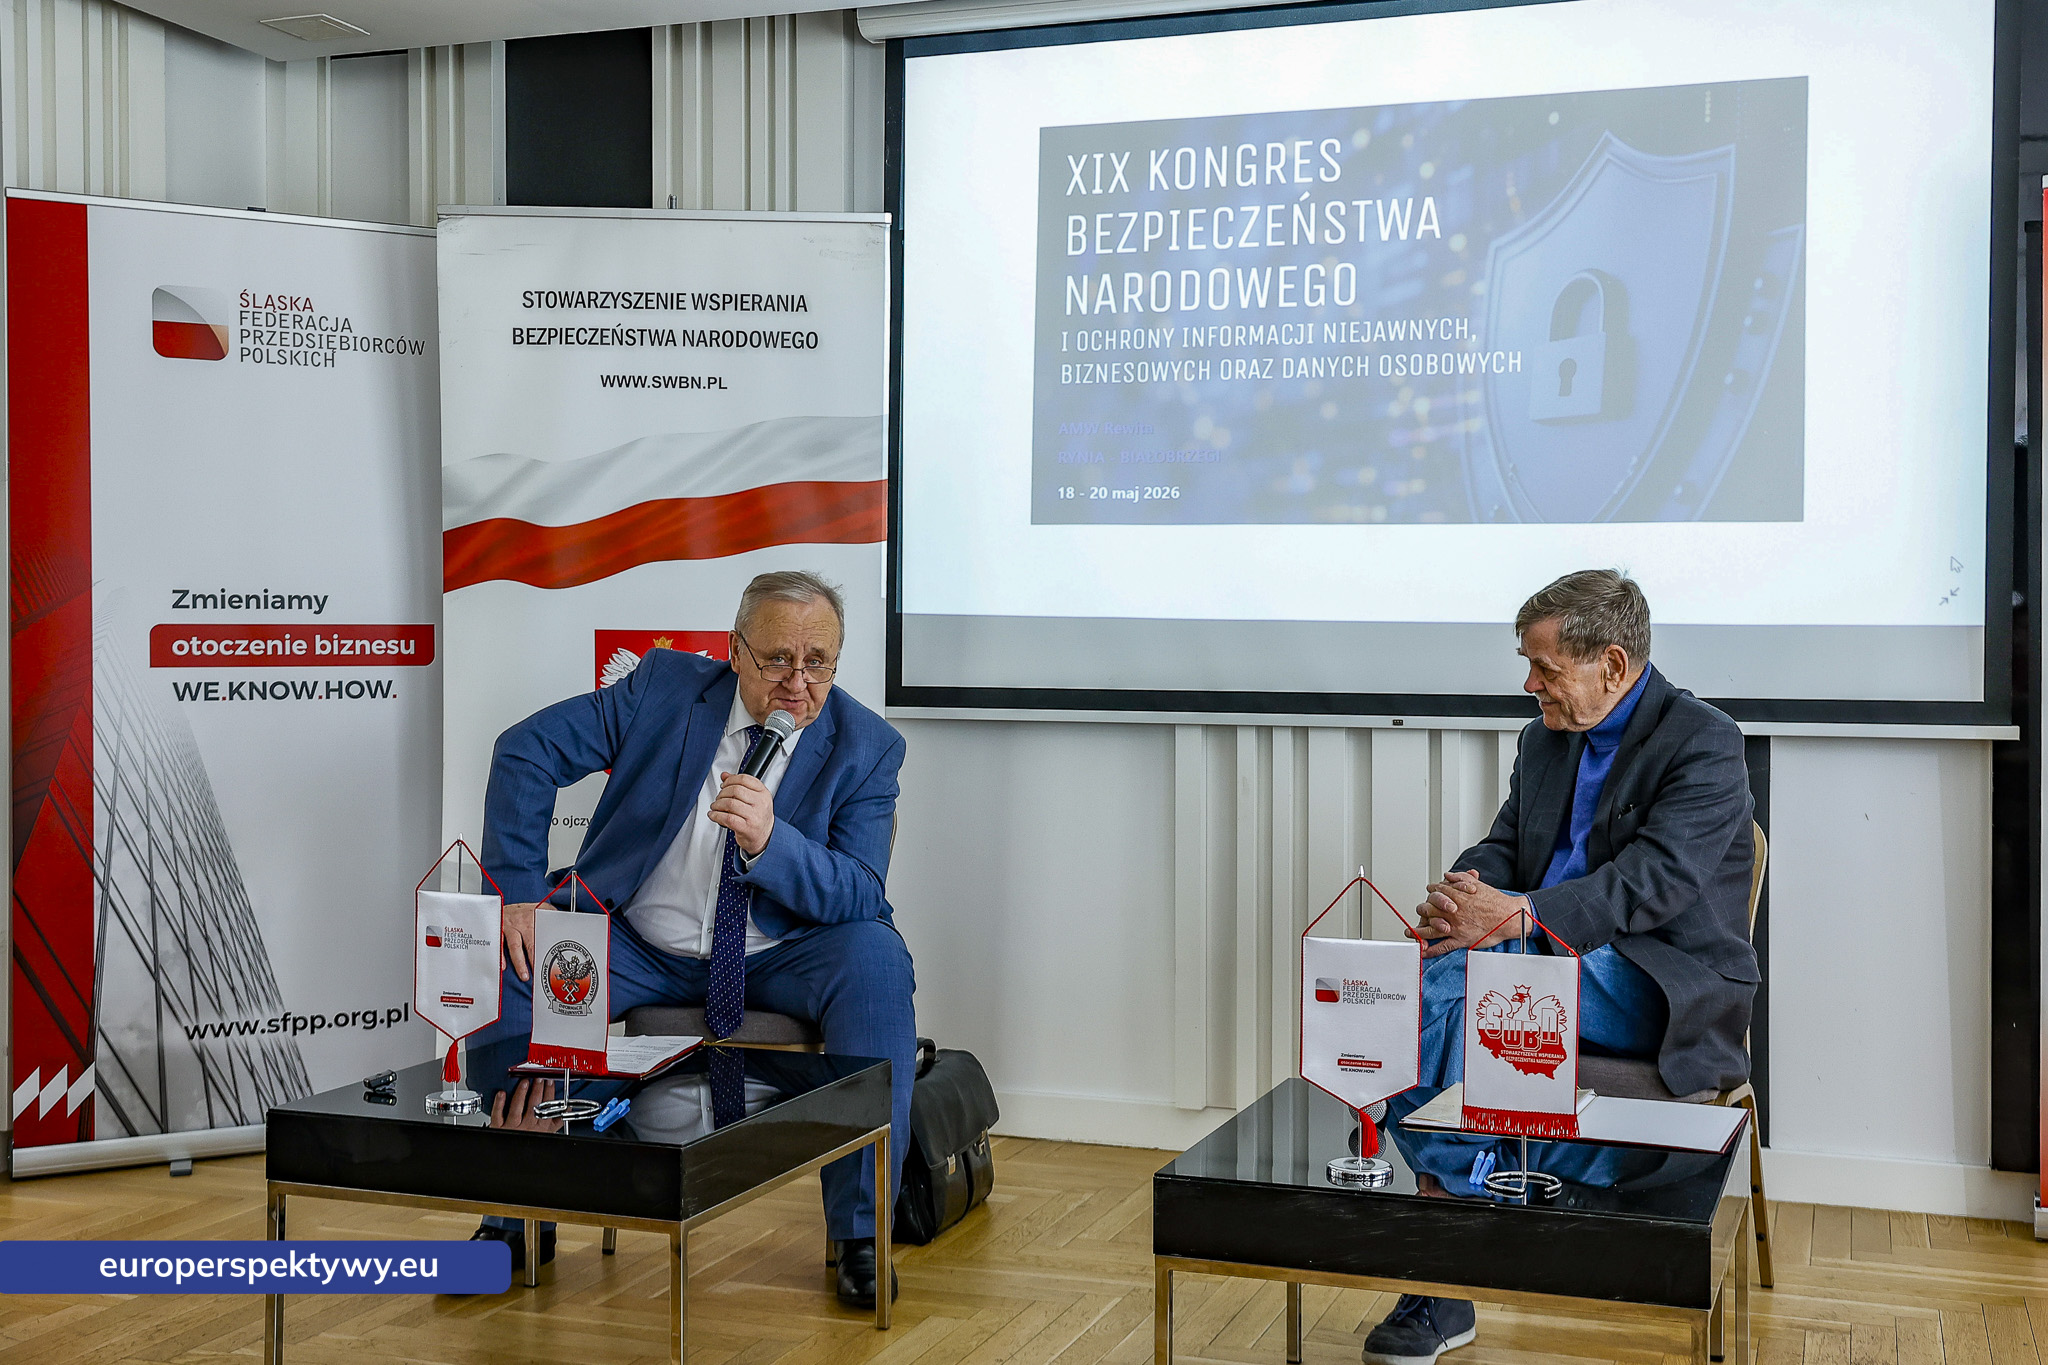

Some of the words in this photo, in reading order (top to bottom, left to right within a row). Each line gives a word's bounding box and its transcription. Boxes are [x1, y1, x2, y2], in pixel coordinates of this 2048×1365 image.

[1065, 152, 1131, 196] XIX
[1149, 137, 1342, 192] KONGRES
[1066, 191, 1442, 256] BEZPIECZEŃSTWA
[239, 289, 314, 313] ŚLĄSKA
[1065, 262, 1357, 315] NARODOWEGO
[522, 290, 687, 311] STOWARZYSZENIE
[691, 293, 808, 313] WSPIERANIA
[239, 311, 353, 333] FEDERACJA
[1060, 331, 1069, 352] I
[1077, 327, 1174, 351] OCHRONY
[1182, 322, 1315, 348] INFORMACJI
[1323, 317, 1477, 344] NIEJAWNYCH,
[239, 329, 426, 356] PRZEDSIĘBIORCÓW
[512, 323, 677, 347] BEZPIECZEŃSTWA
[682, 329, 819, 349] NARODOWEGO
[239, 347, 336, 368] POLSKICH
[1061, 359, 1211, 384] BIZNESOWYCH
[1220, 358, 1274, 380] ORAZ
[1282, 354, 1370, 378] DANYCH
[1379, 351, 1523, 376] OSOBOWYCH
[600, 375, 728, 390] WWW.SWBN.PL
[1058, 487, 1075, 499] 18
[1089, 487, 1108, 499] 20
[1112, 486, 1140, 503] maj
[1143, 486, 1180, 499] 2026
[171, 588, 329, 615] Zmieniamy
[171, 633, 308, 656] otoczenie
[314, 633, 416, 655] biznesu
[172, 679, 398, 701] WE.KNOW.HOW.
[562, 815, 591, 829] ojczy
[184, 1002, 410, 1040] www.sfpp.org.pl
